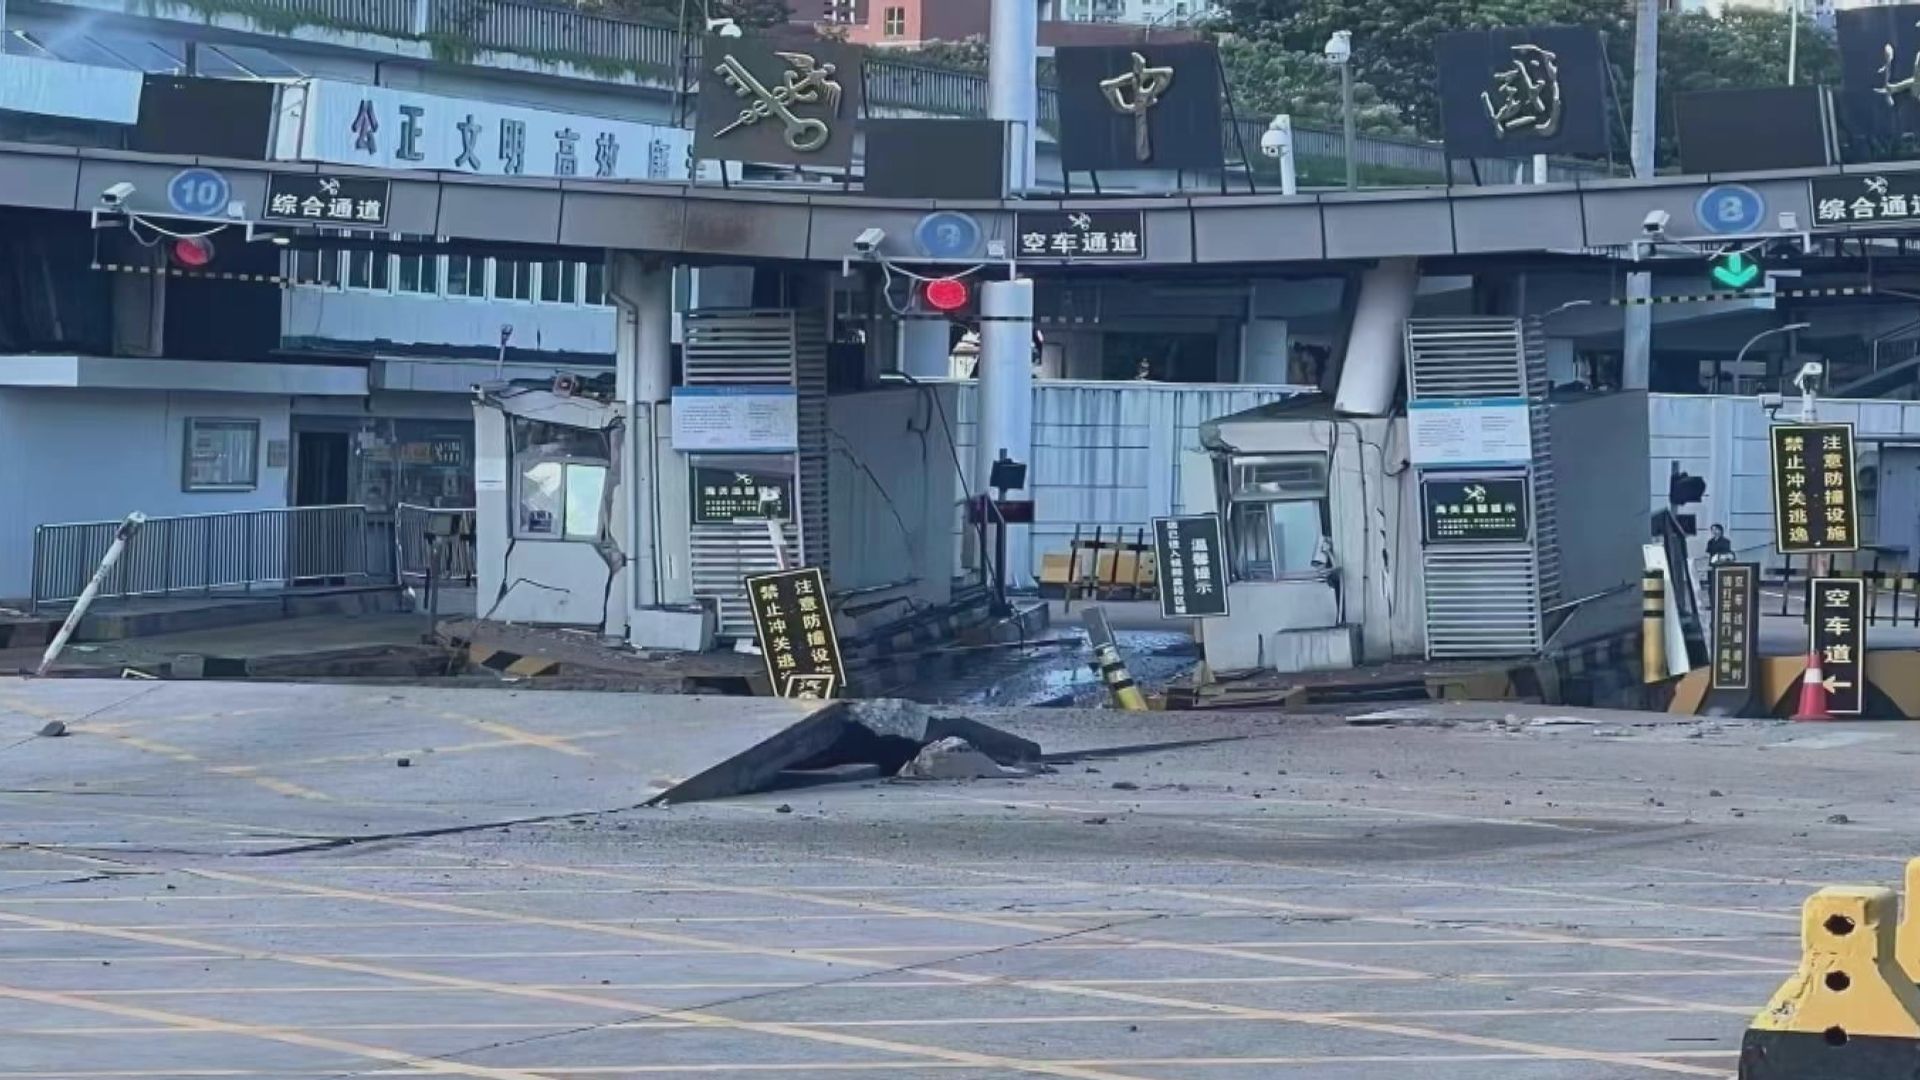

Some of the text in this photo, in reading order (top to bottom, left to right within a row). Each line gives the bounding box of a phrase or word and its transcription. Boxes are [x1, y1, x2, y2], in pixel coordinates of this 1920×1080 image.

[1099, 51, 1174, 161] 中
[181, 179, 218, 205] 10
[271, 193, 382, 221] 综合通道
[1022, 231, 1138, 254] 空车通道
[1784, 436, 1809, 542] 禁止冲关逃逸
[1822, 434, 1847, 541] 注意防撞设施
[1823, 588, 1852, 664] 空车道
